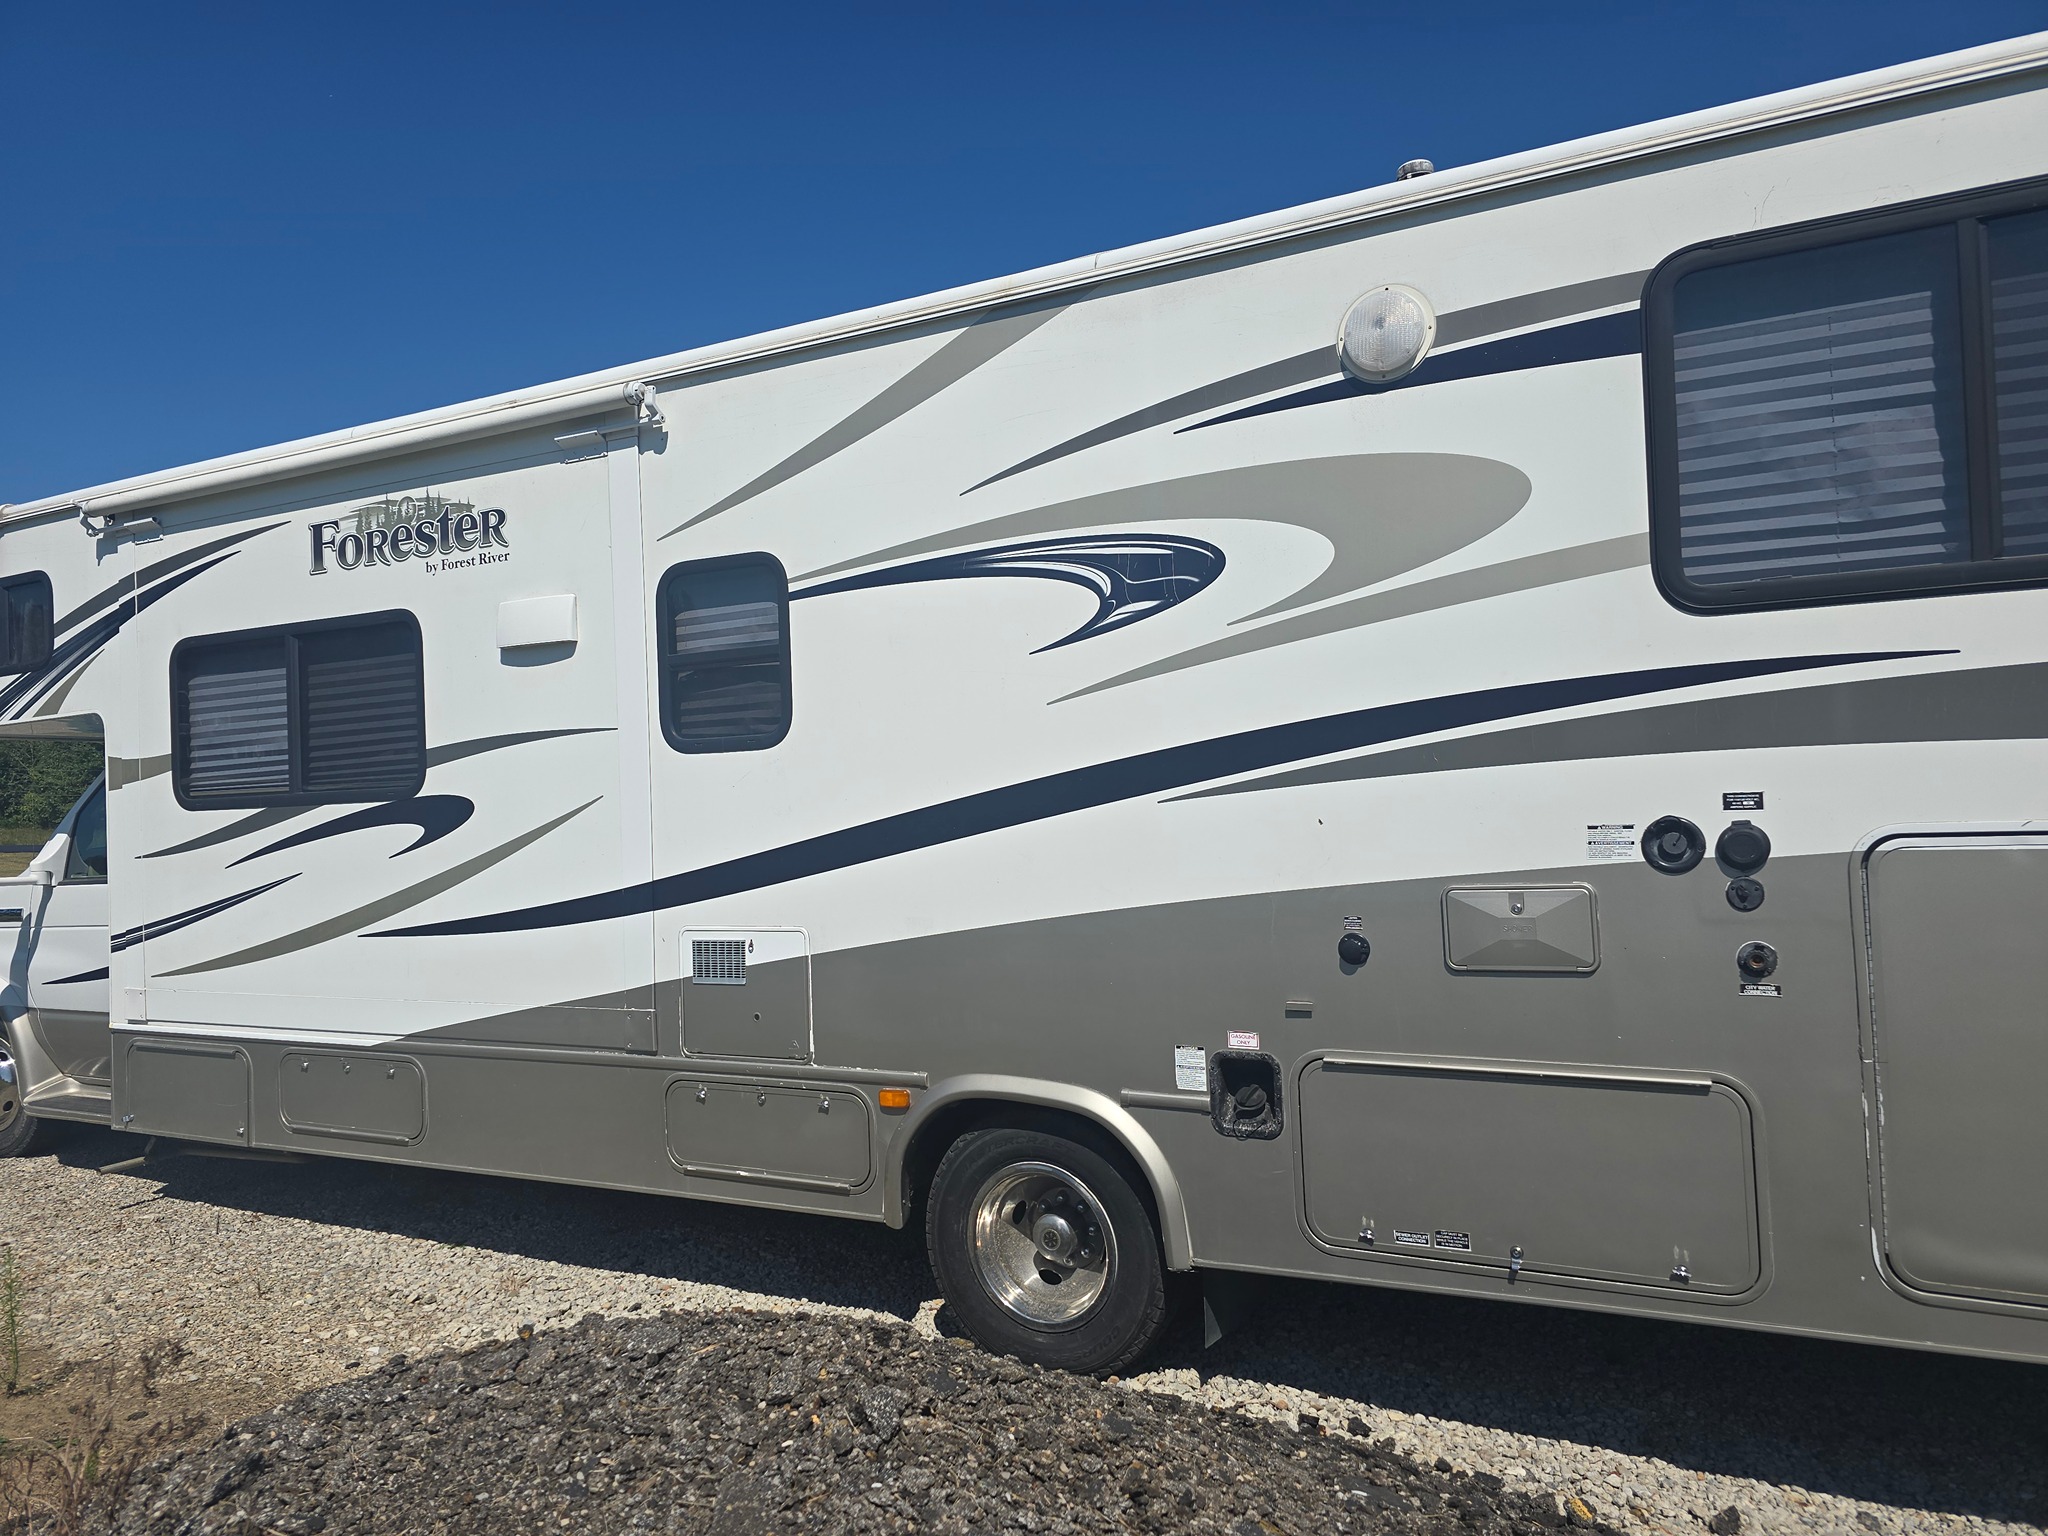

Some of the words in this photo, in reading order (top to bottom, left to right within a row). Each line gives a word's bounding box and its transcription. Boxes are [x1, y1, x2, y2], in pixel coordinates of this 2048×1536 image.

[425, 561, 438, 576] by
[441, 556, 476, 573] Forest
[478, 551, 510, 567] River
